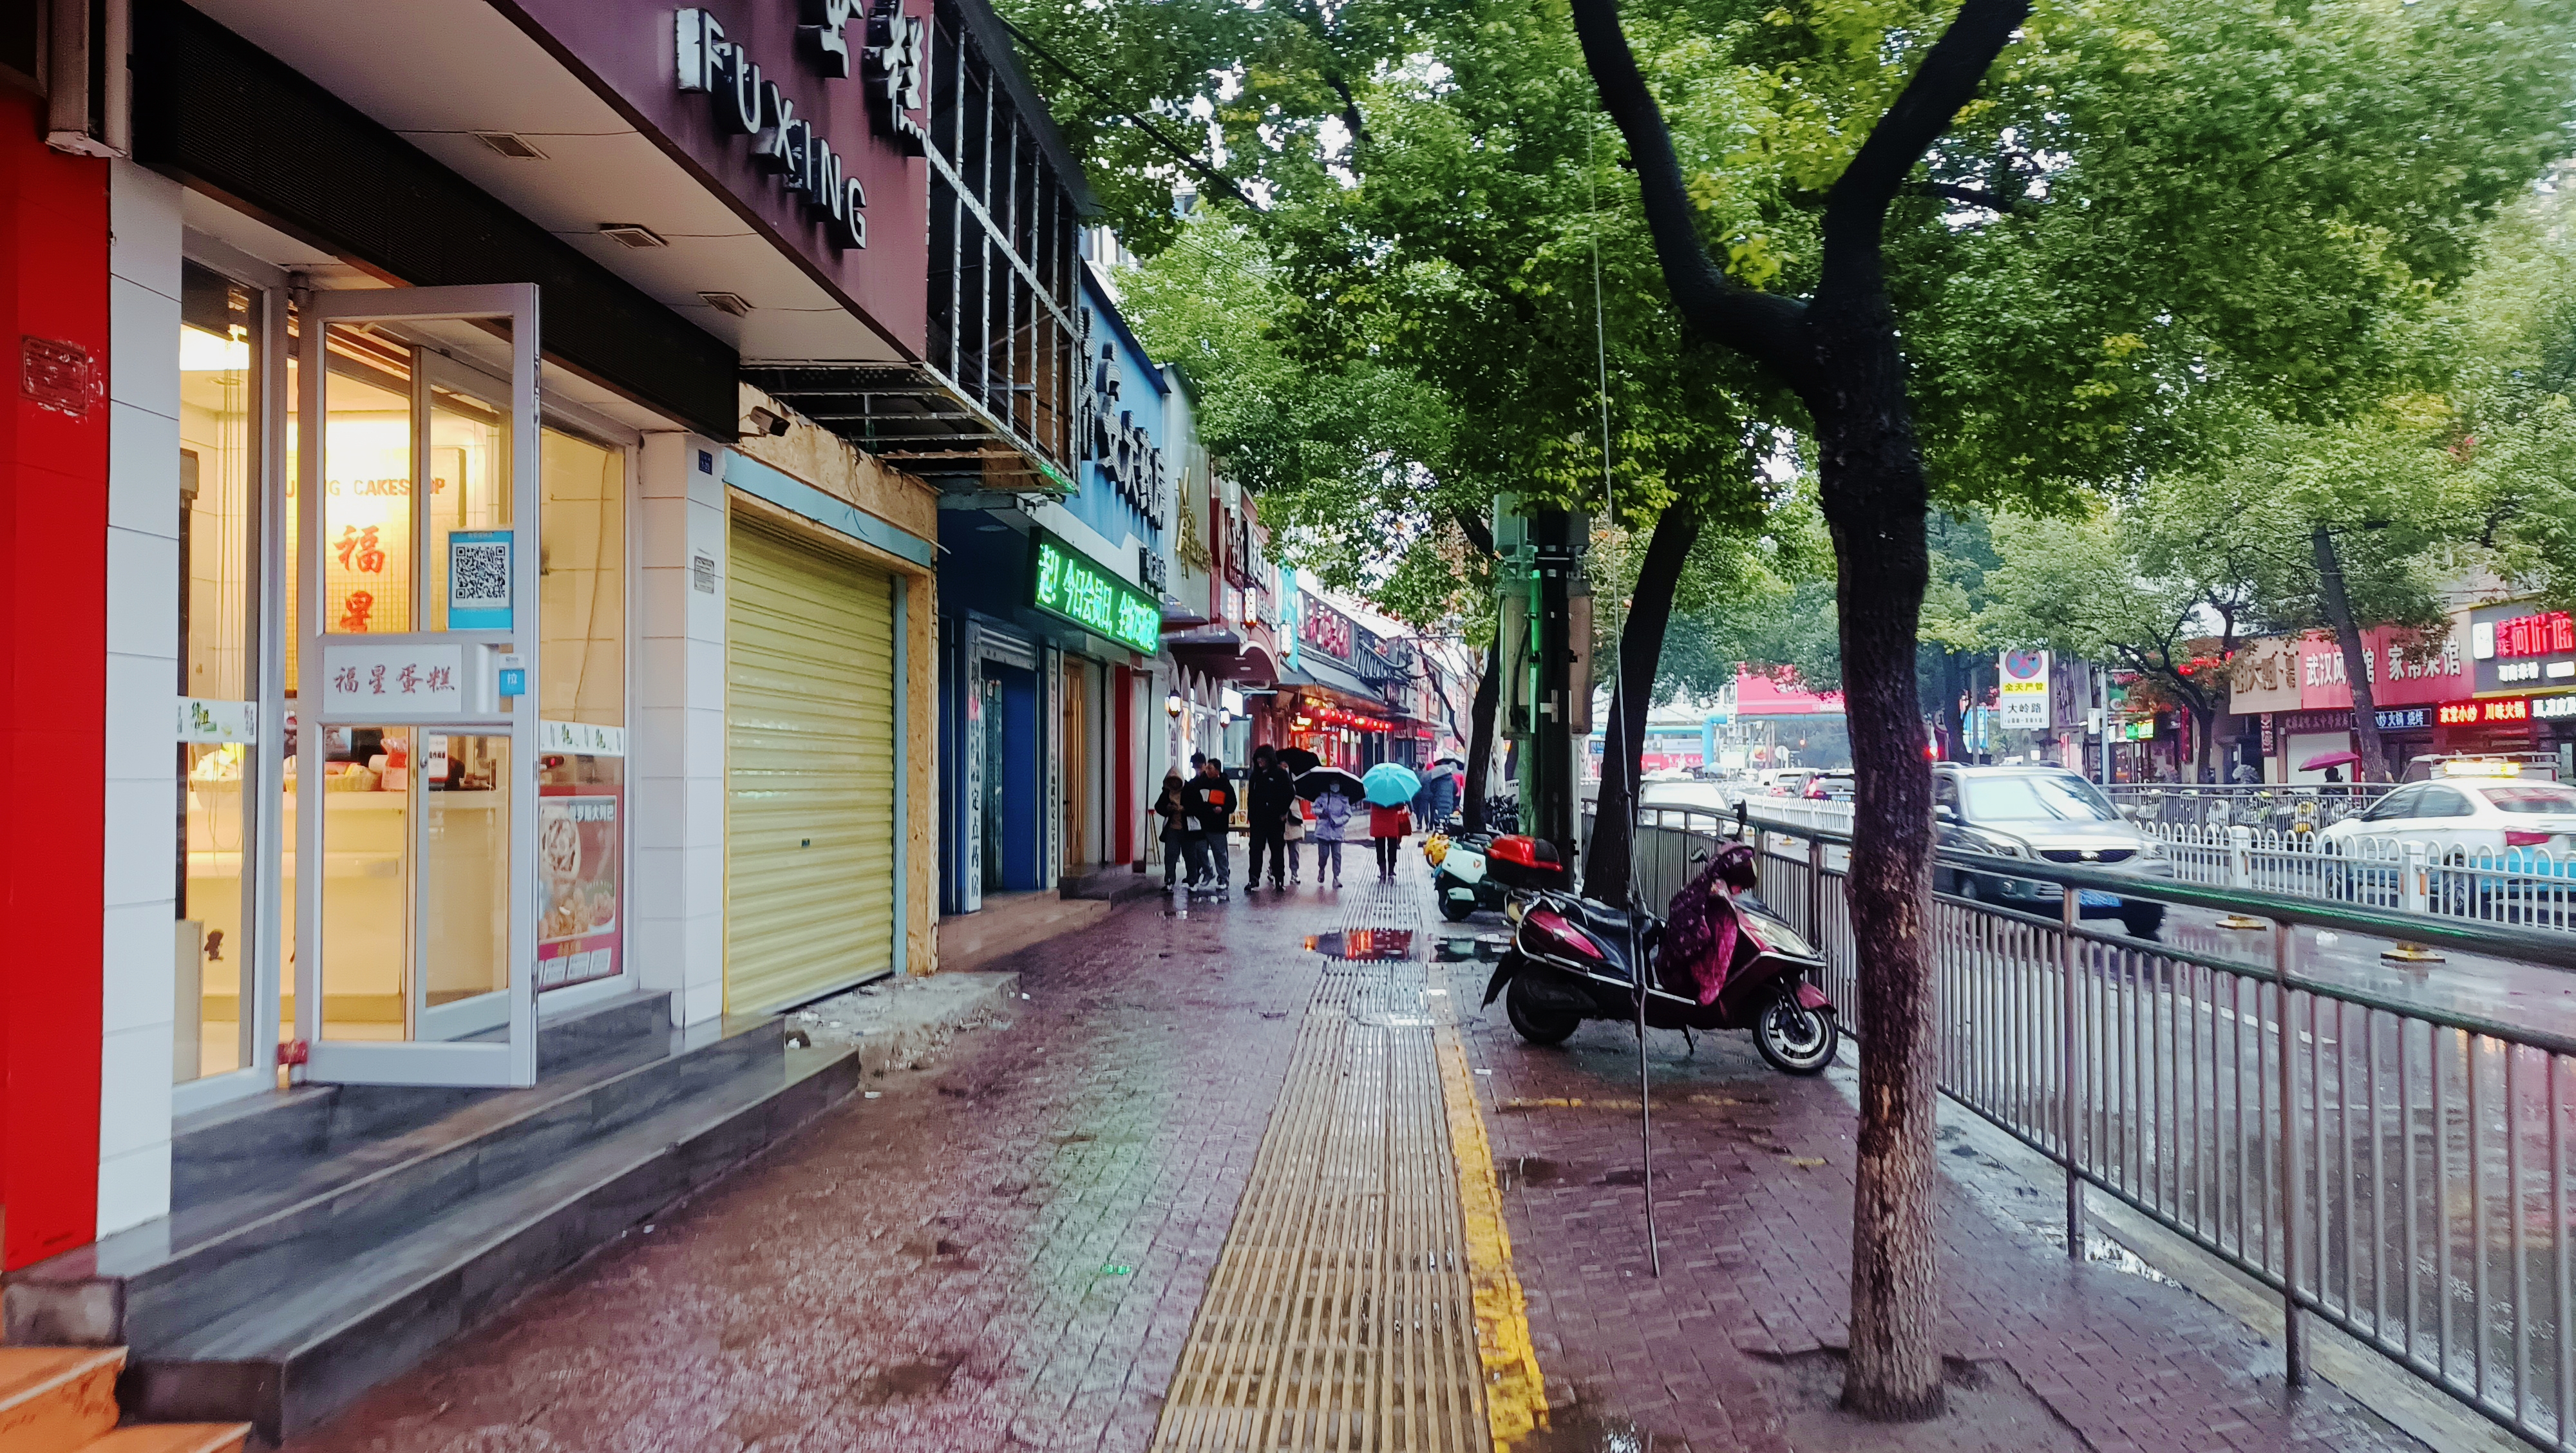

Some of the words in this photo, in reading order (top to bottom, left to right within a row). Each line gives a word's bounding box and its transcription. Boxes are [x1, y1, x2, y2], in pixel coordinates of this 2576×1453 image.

[702, 9, 867, 249] FUXING
[332, 661, 456, 696] 福星蛋糕
[2007, 702, 2041, 714] 大岭路
[2484, 700, 2526, 721] 川味火锅
